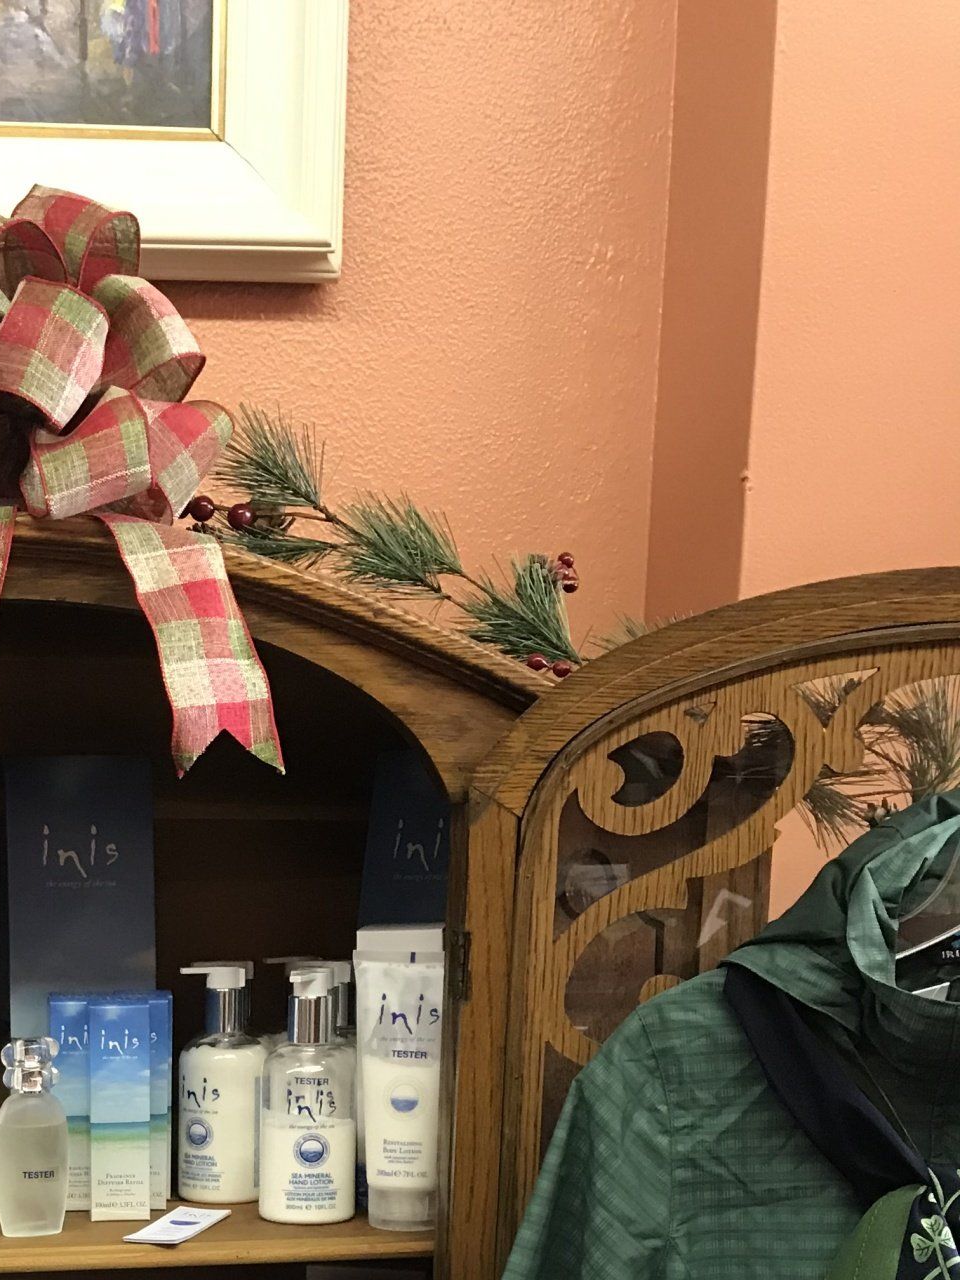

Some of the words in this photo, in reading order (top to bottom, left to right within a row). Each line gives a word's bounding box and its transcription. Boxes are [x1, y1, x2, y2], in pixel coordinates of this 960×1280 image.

[42, 824, 120, 879] inis
[379, 993, 440, 1035] inis
[100, 1029, 140, 1055] inis
[392, 1050, 428, 1059] TESTER
[182, 1075, 220, 1108] inis
[294, 1077, 329, 1086] TESTER
[22, 1170, 55, 1179] TESTER
